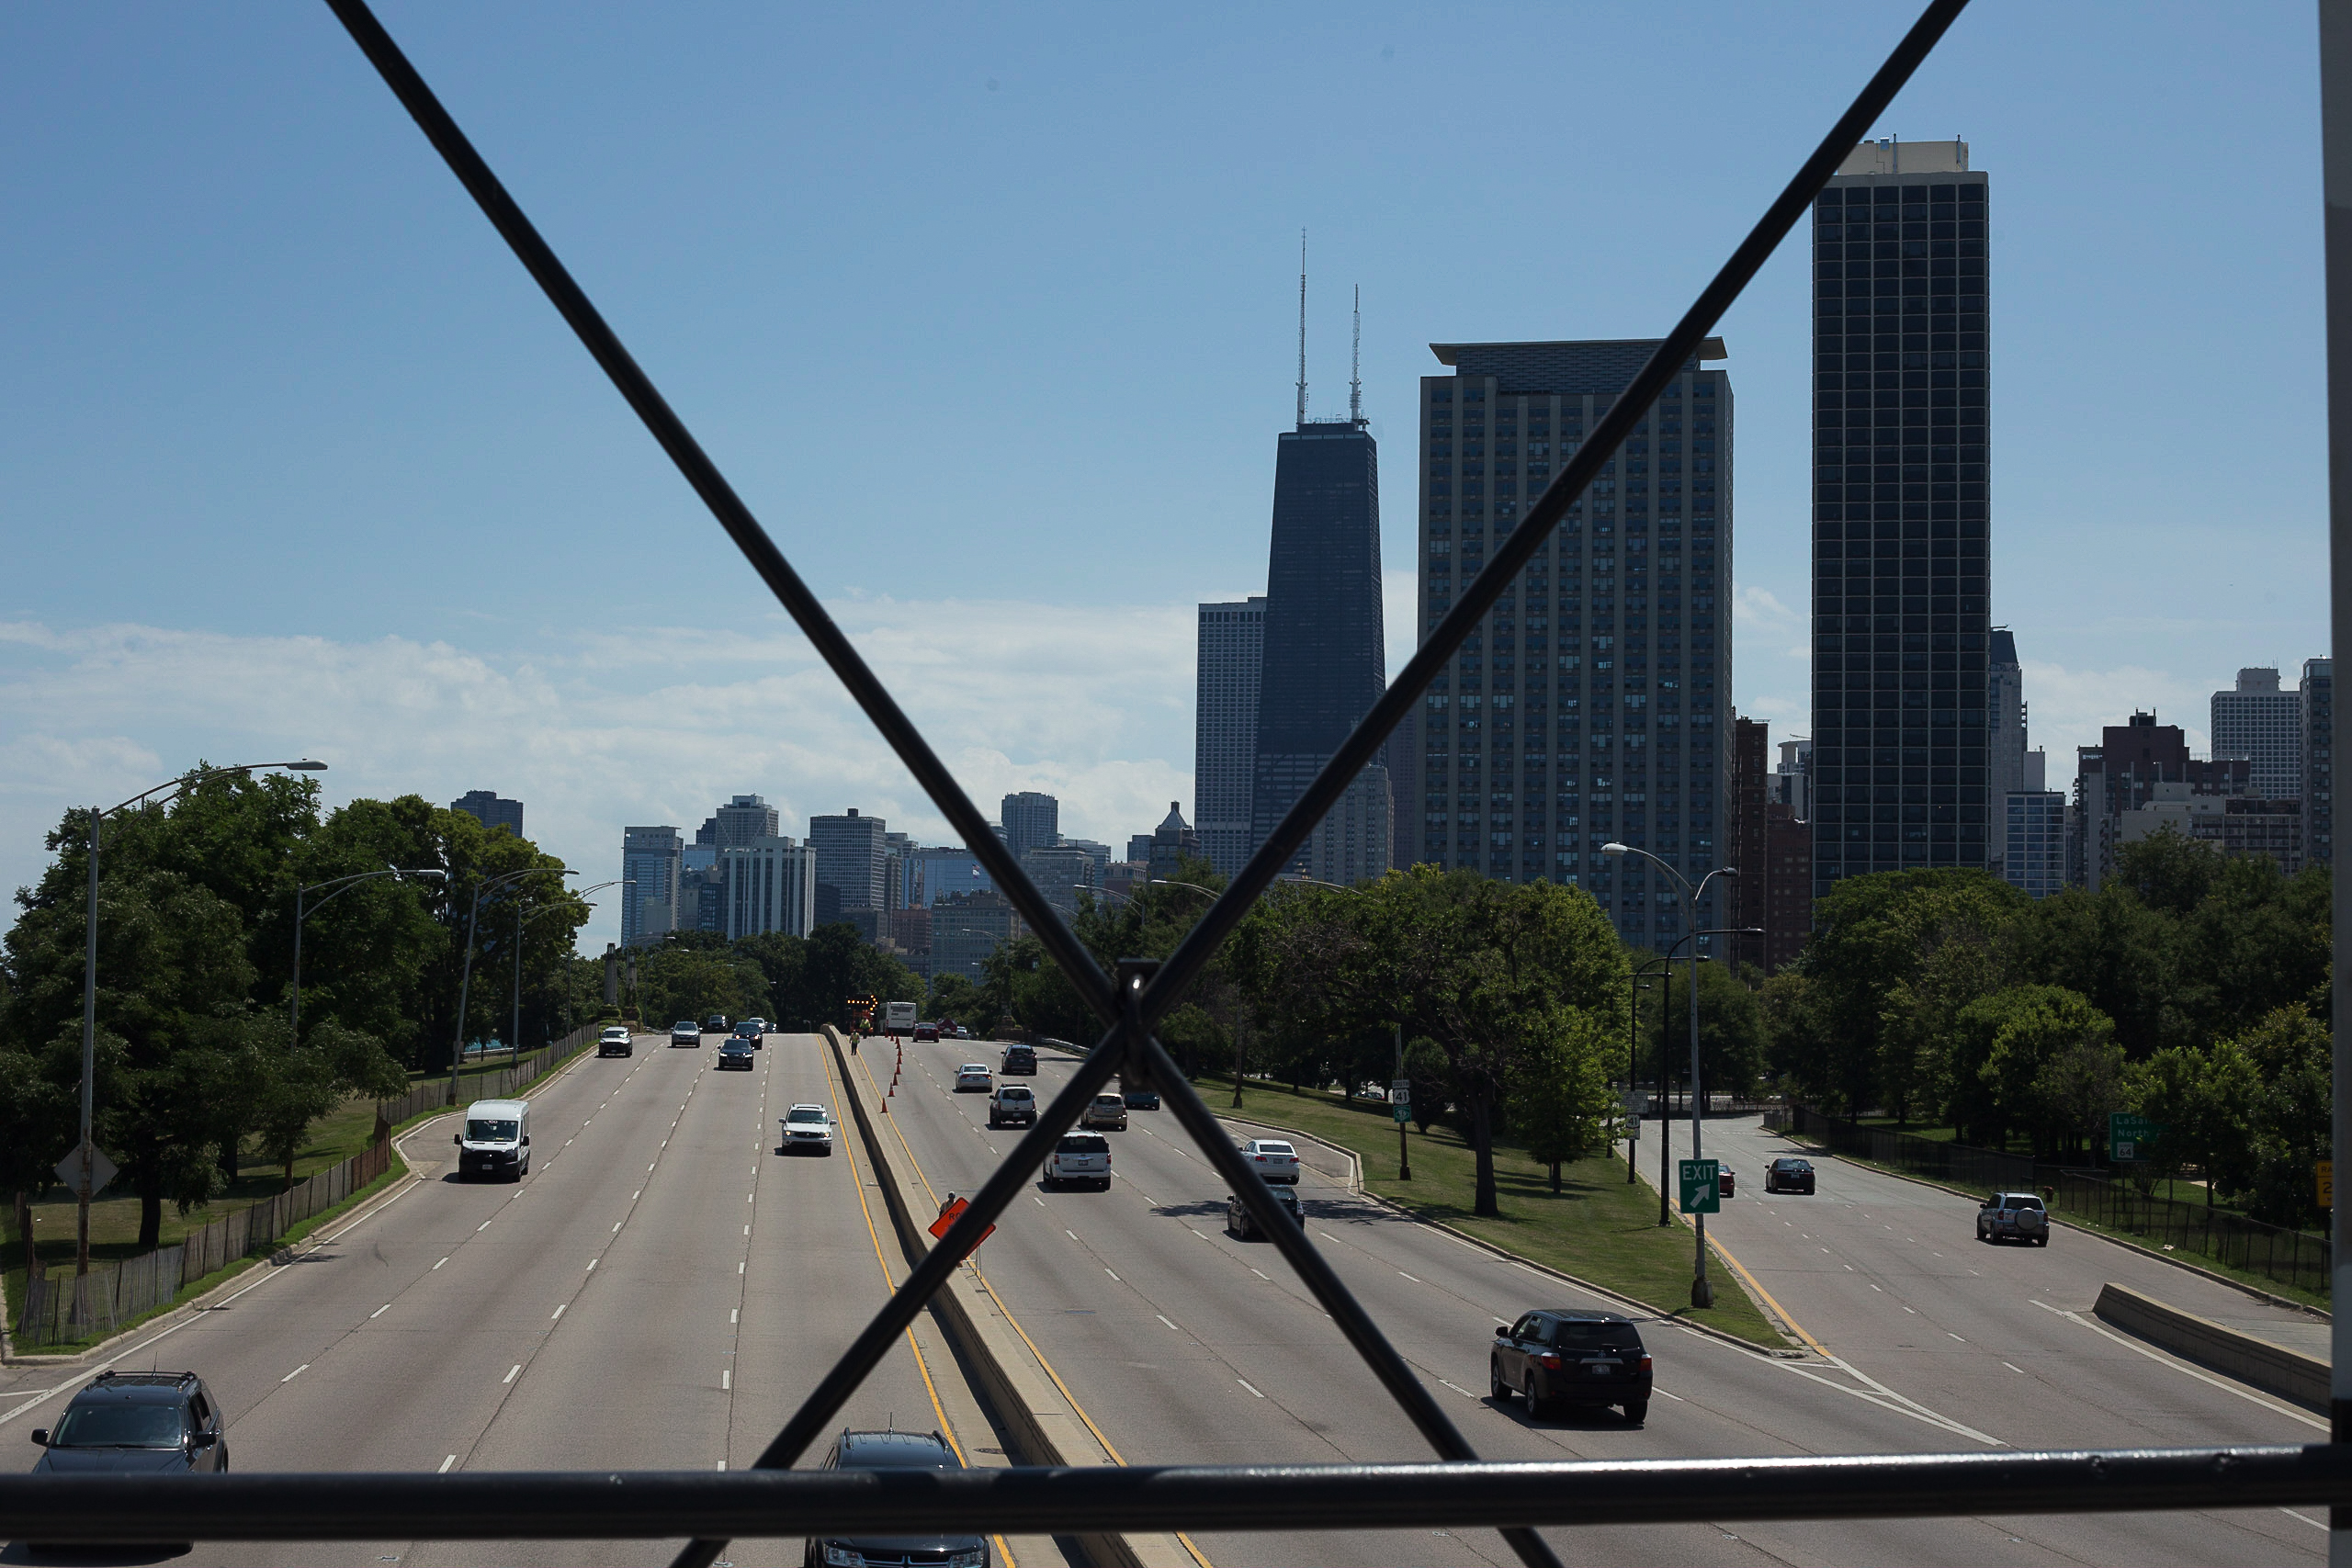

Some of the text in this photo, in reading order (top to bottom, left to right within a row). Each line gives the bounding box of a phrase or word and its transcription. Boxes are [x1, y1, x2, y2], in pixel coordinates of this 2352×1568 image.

[1396, 1091, 1408, 1101] 41
[1628, 1117, 1637, 1125] 41
[2118, 1129, 2149, 1137] North
[2120, 1148, 2132, 1156] 64
[1682, 1165, 1715, 1180] EXIT
[2323, 1181, 2333, 1194] 2
